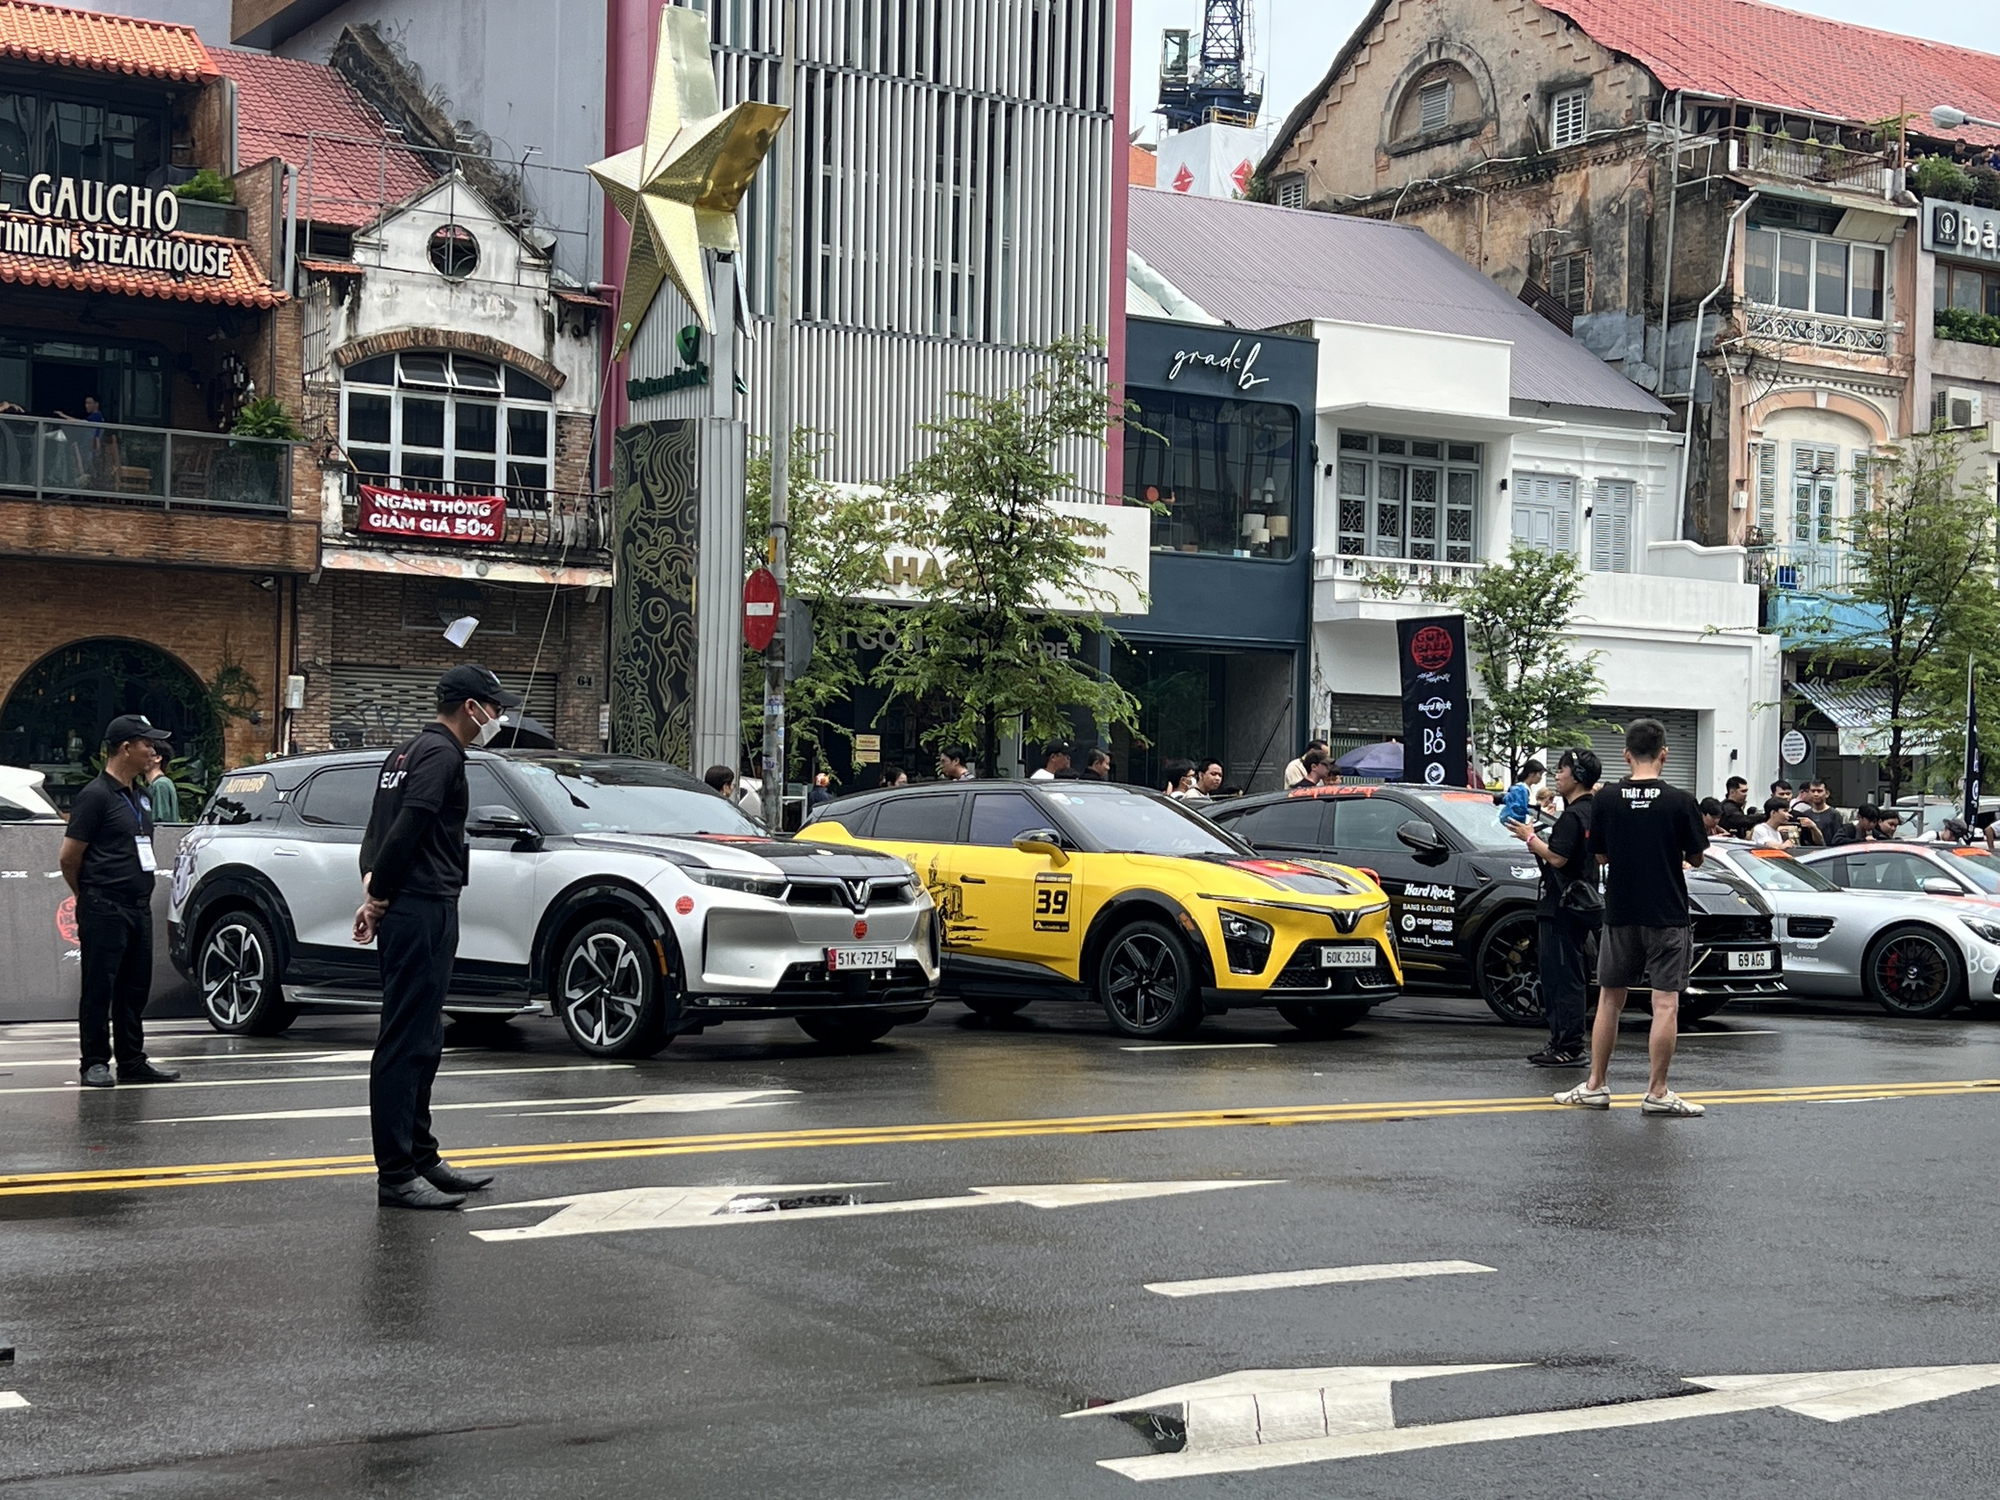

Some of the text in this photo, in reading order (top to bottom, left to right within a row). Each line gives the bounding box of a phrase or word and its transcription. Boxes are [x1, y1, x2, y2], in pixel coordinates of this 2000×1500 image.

[28, 173, 180, 232] GAUCHO
[79, 230, 232, 277] STEAKHOUSE
[374, 493, 491, 517] NGÀN THÔNG
[420, 516, 451, 533] GIÁ
[454, 518, 495, 537] 50%
[577, 675, 592, 687] 64
[1035, 889, 1069, 915] 39
[1404, 883, 1456, 901] Hard Rock
[1738, 953, 1750, 967] 69
